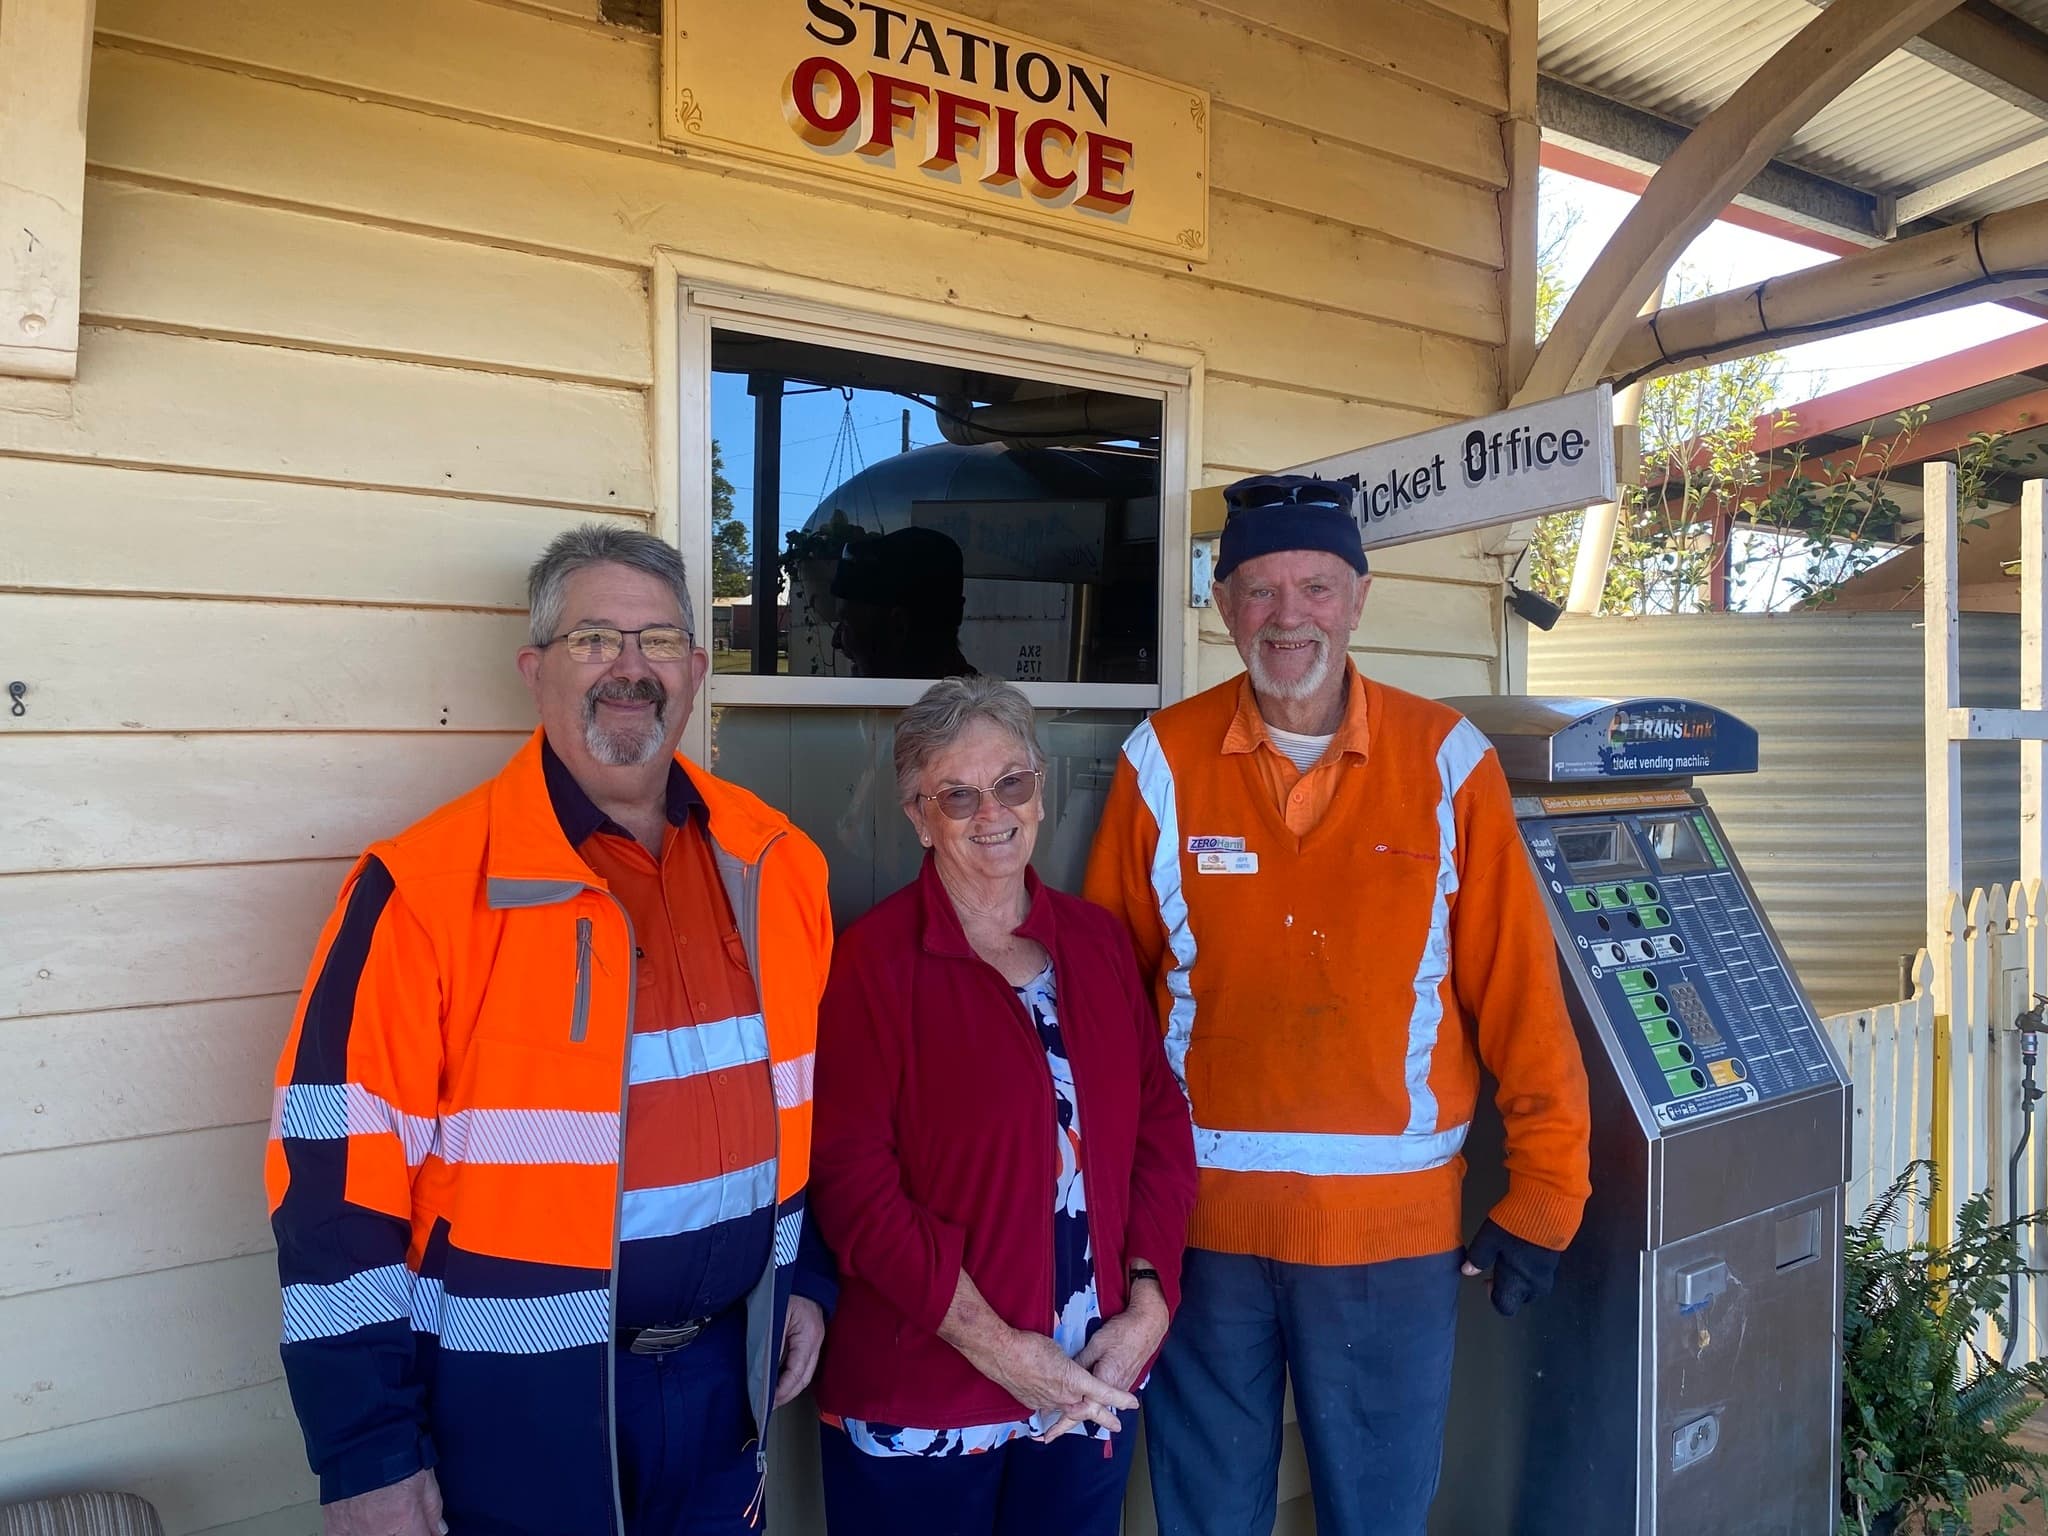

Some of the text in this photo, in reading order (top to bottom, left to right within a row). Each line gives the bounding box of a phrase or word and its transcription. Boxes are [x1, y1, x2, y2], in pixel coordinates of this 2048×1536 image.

[805, 0, 1110, 127] STATION
[788, 56, 1135, 212] OFFICE
[1463, 428, 1584, 483] Office
[1613, 757, 1638, 770] ticket
[1639, 756, 1674, 771] vending
[1675, 754, 1711, 768] machine
